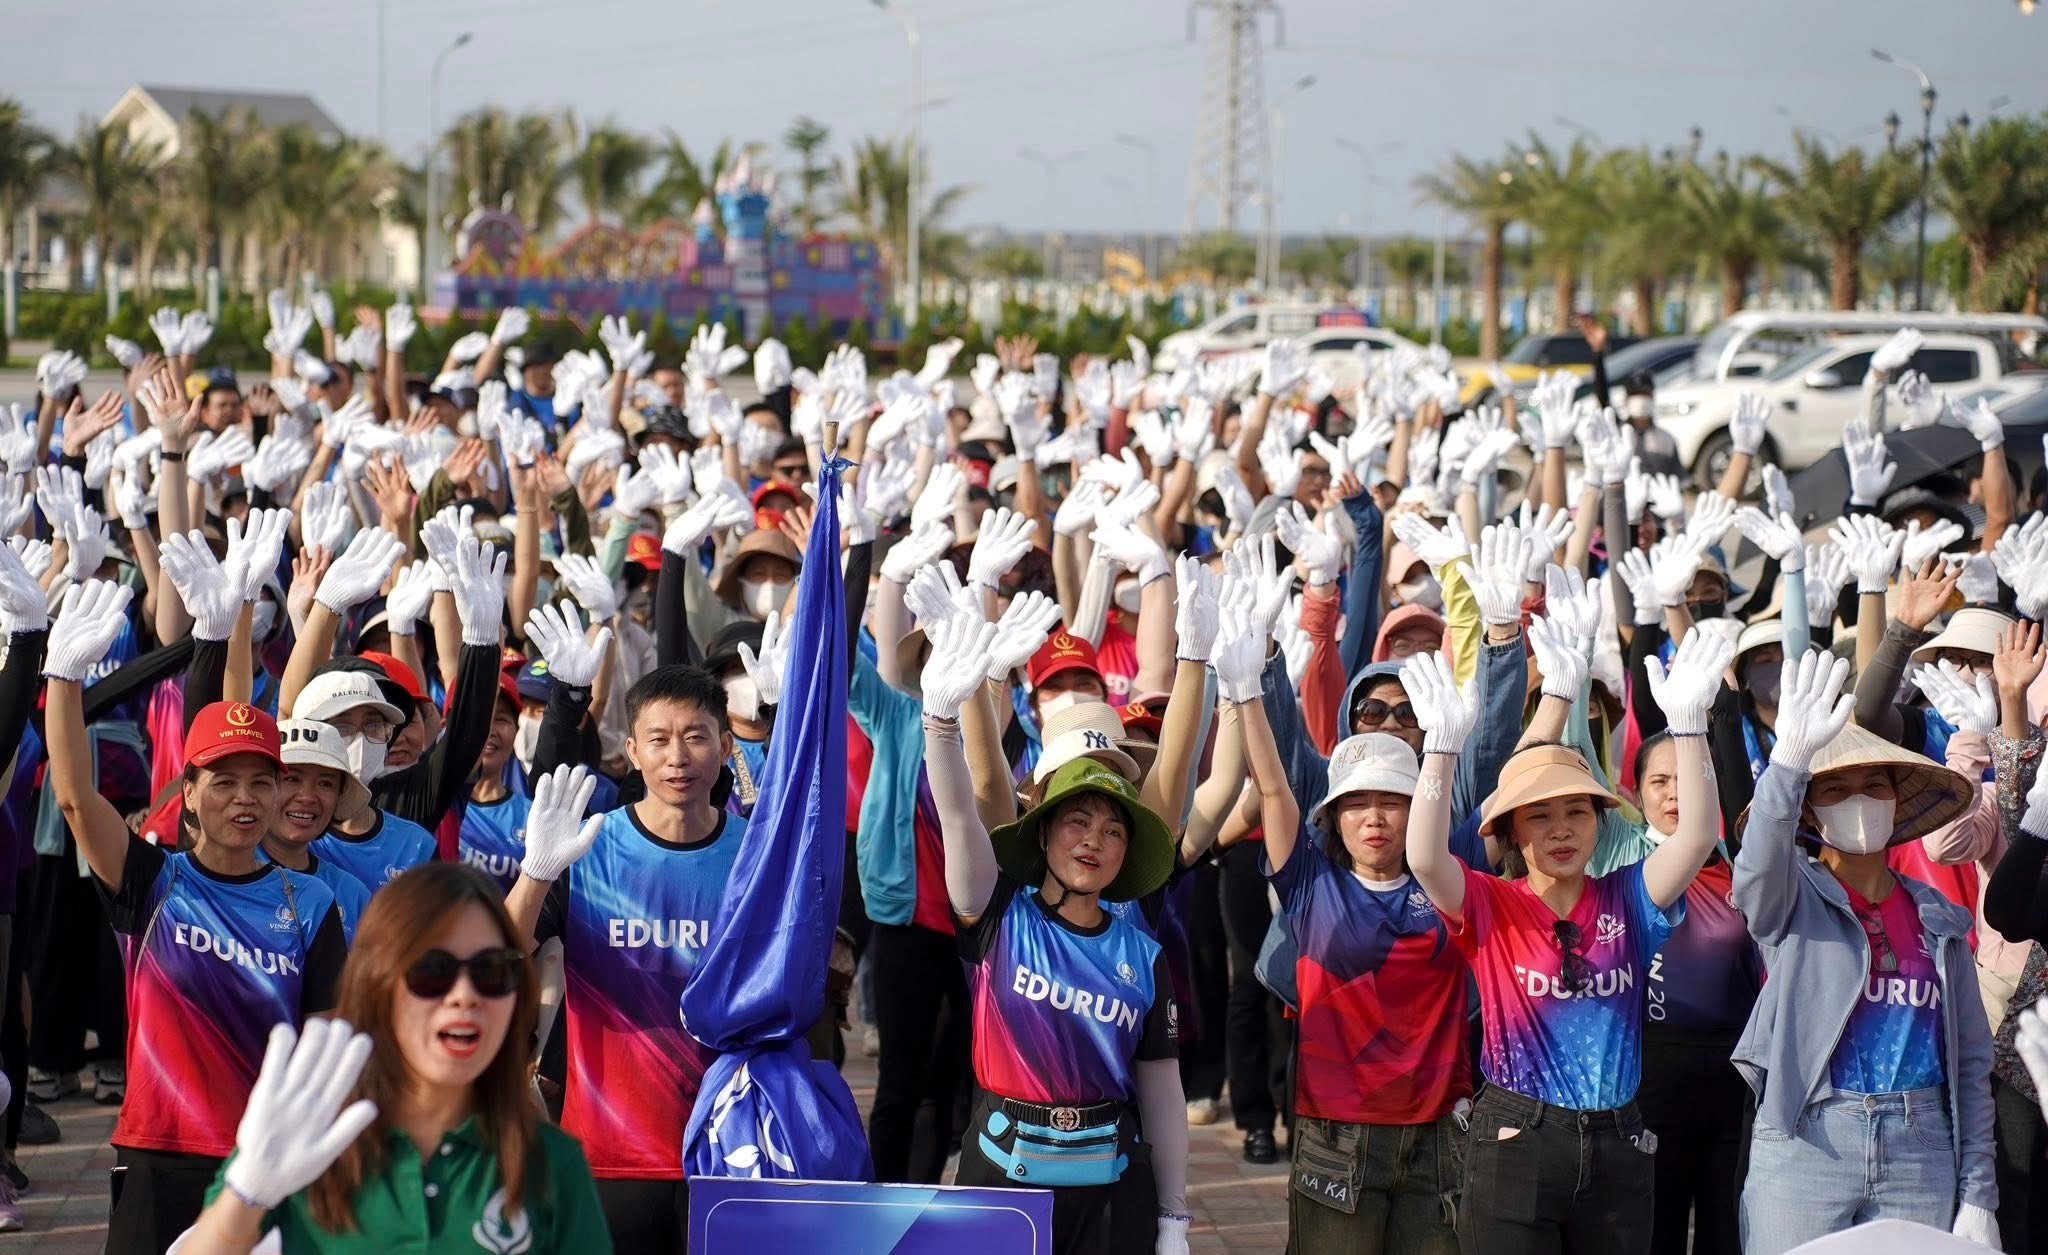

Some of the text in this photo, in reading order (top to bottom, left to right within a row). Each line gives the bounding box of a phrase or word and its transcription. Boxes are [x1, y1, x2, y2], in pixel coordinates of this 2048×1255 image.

[86, 659, 121, 684] RU
[219, 729, 264, 739] VIN TRAVEL
[175, 922, 300, 976] EDURUN
[1013, 964, 1138, 1033] EDURUN
[1324, 1181, 1347, 1201] KA
